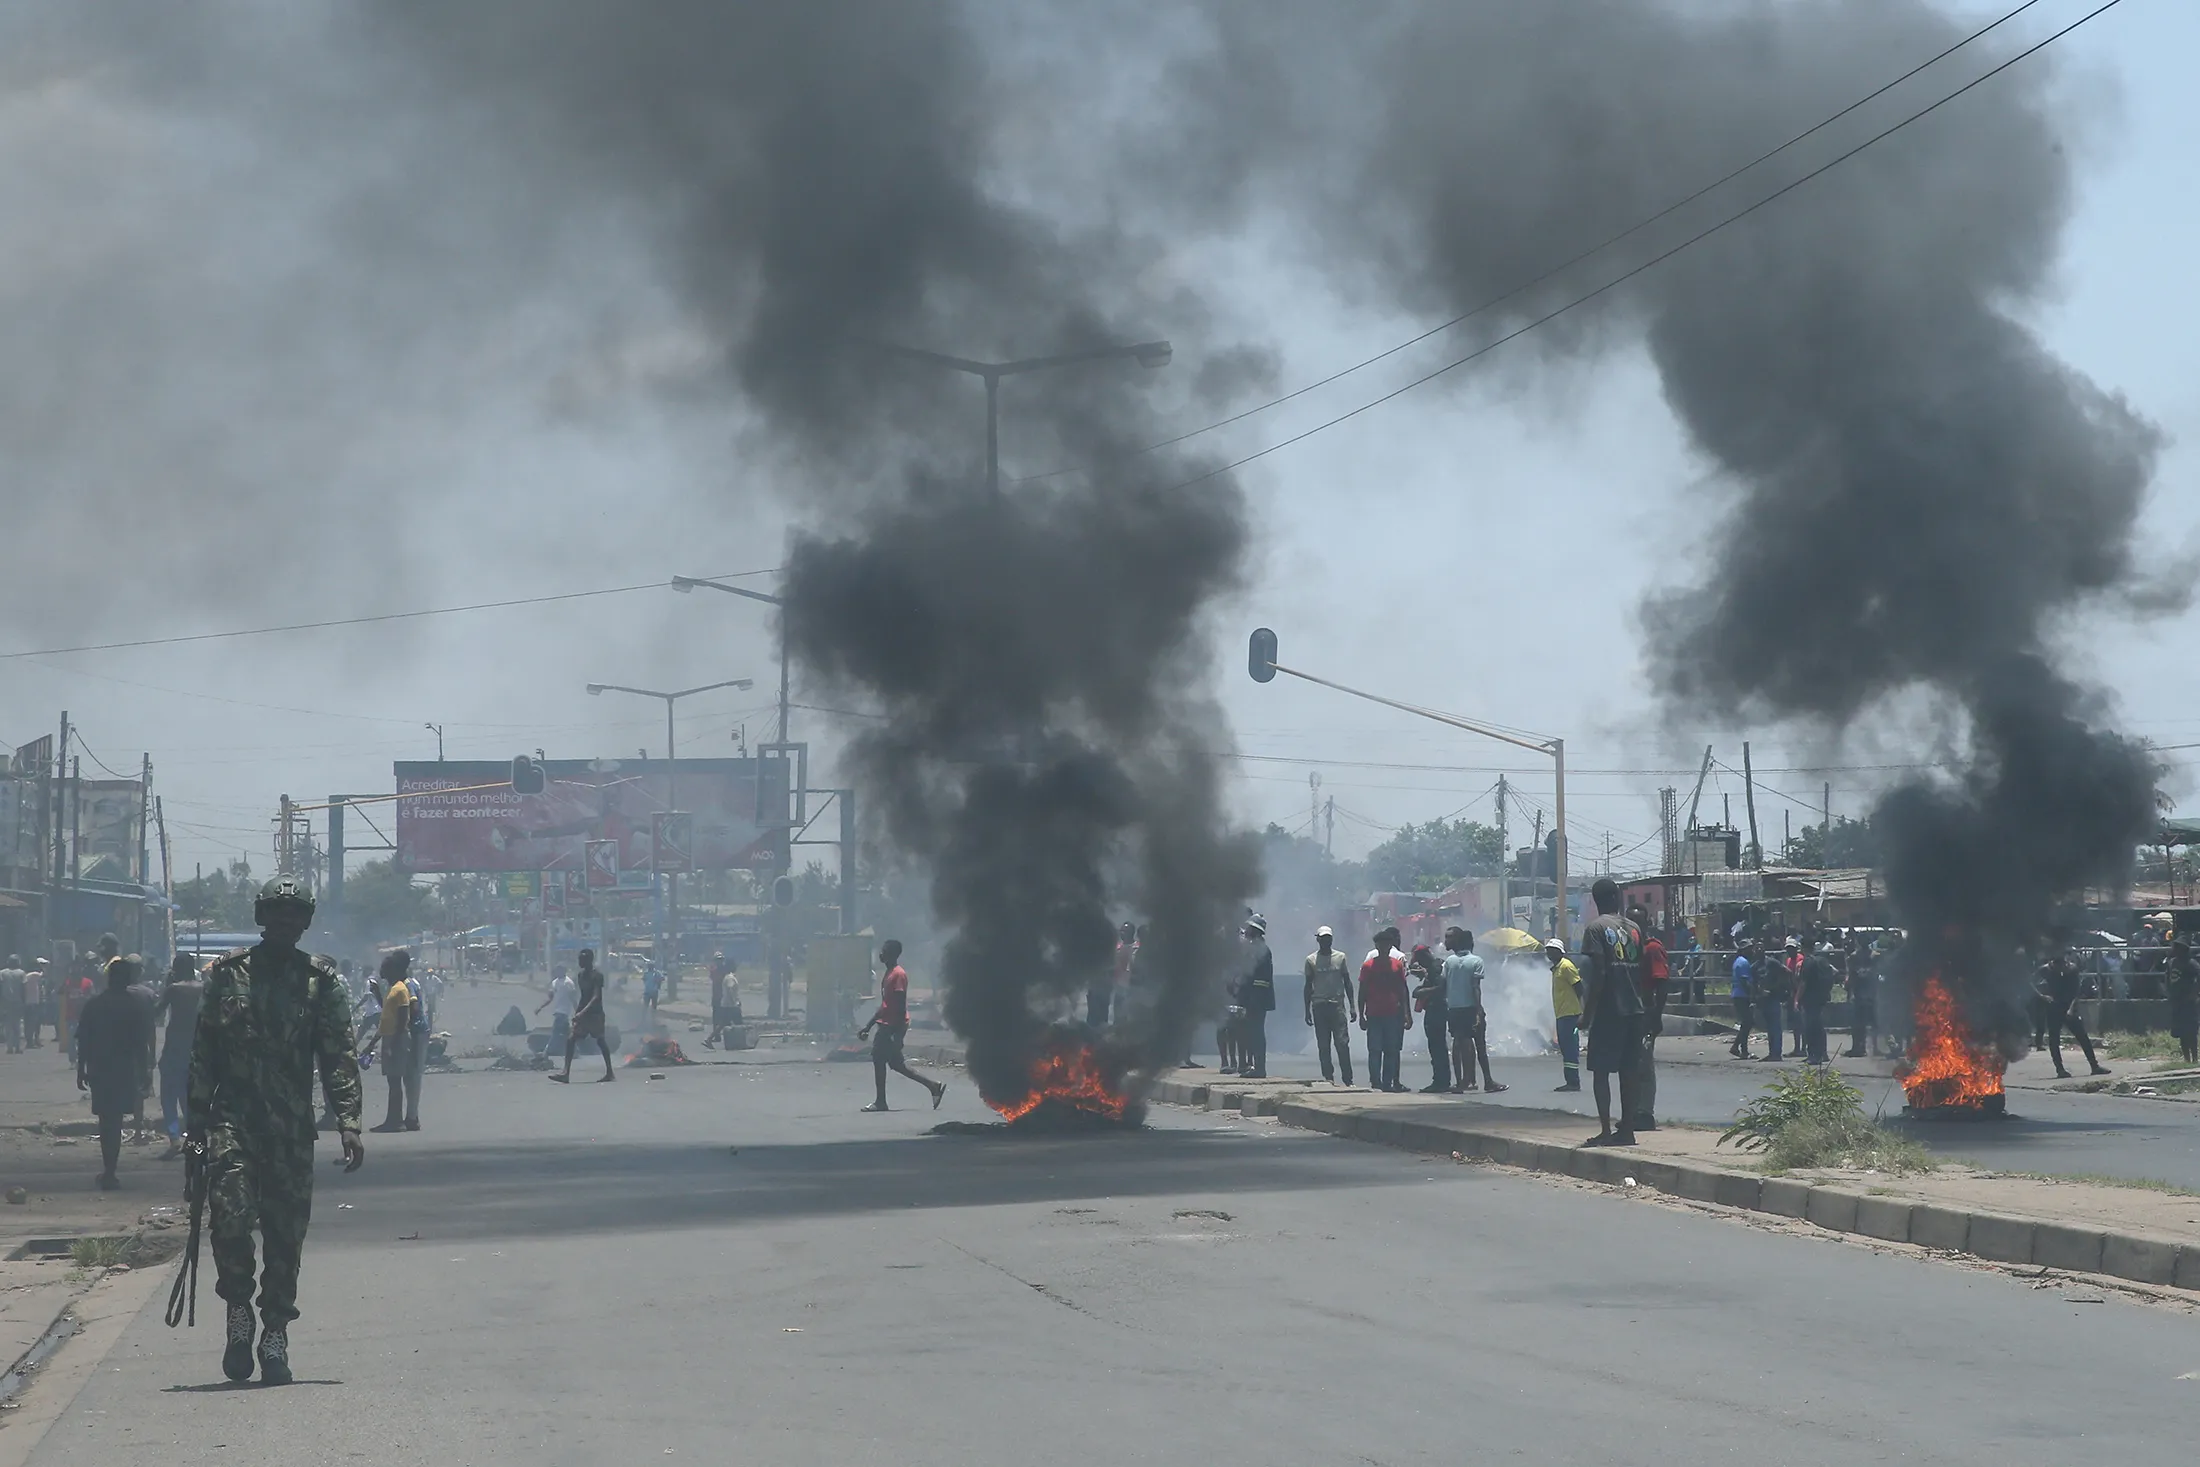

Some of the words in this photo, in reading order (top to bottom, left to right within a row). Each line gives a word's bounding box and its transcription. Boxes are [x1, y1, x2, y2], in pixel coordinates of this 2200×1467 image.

[402, 779, 460, 790] Acreditar
[432, 792, 478, 804] mundo
[402, 807, 410, 818] é
[414, 806, 449, 818] fazer
[452, 807, 524, 818] acontecer.
